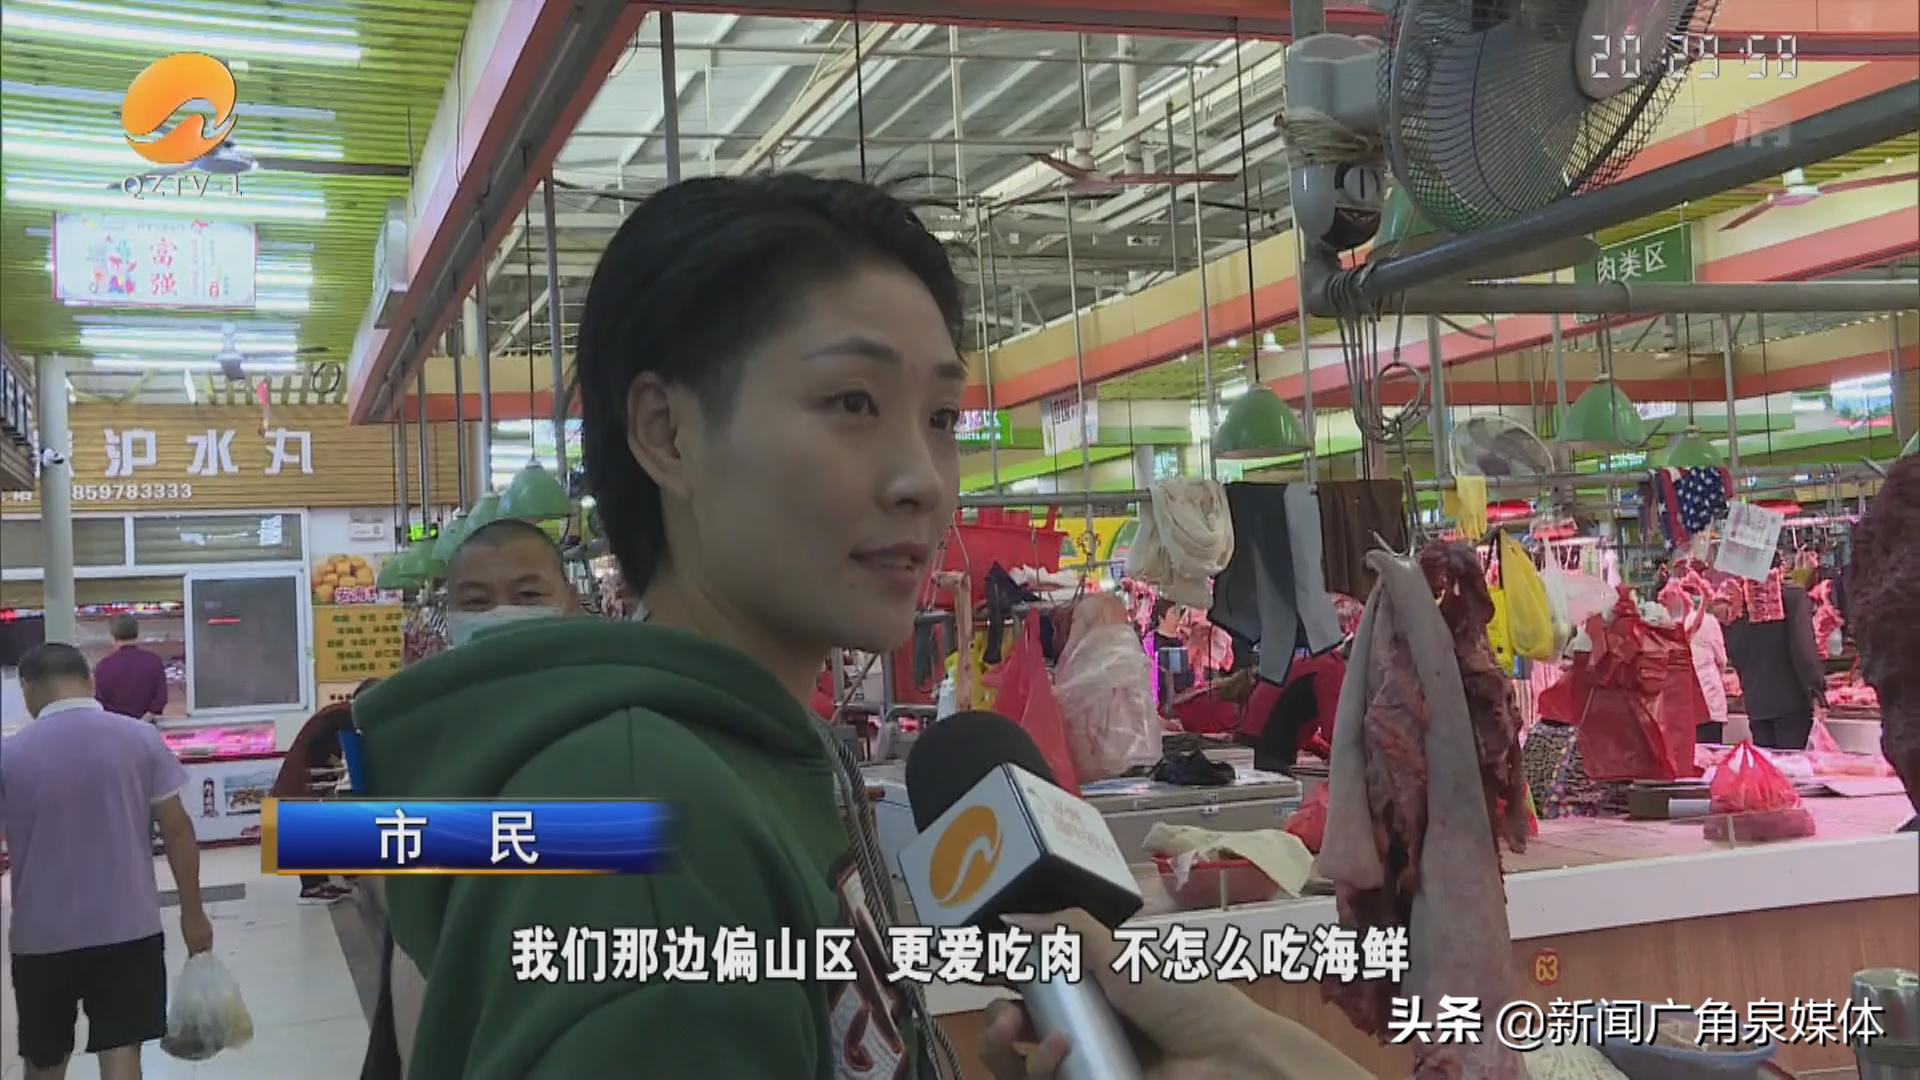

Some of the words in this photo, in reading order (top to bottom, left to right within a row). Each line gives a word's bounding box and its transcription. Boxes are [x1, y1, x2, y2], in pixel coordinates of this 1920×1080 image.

[1597, 241, 1667, 284] 肉类区
[33, 427, 314, 478] 沪水丸
[1536, 955, 1558, 980] 63
